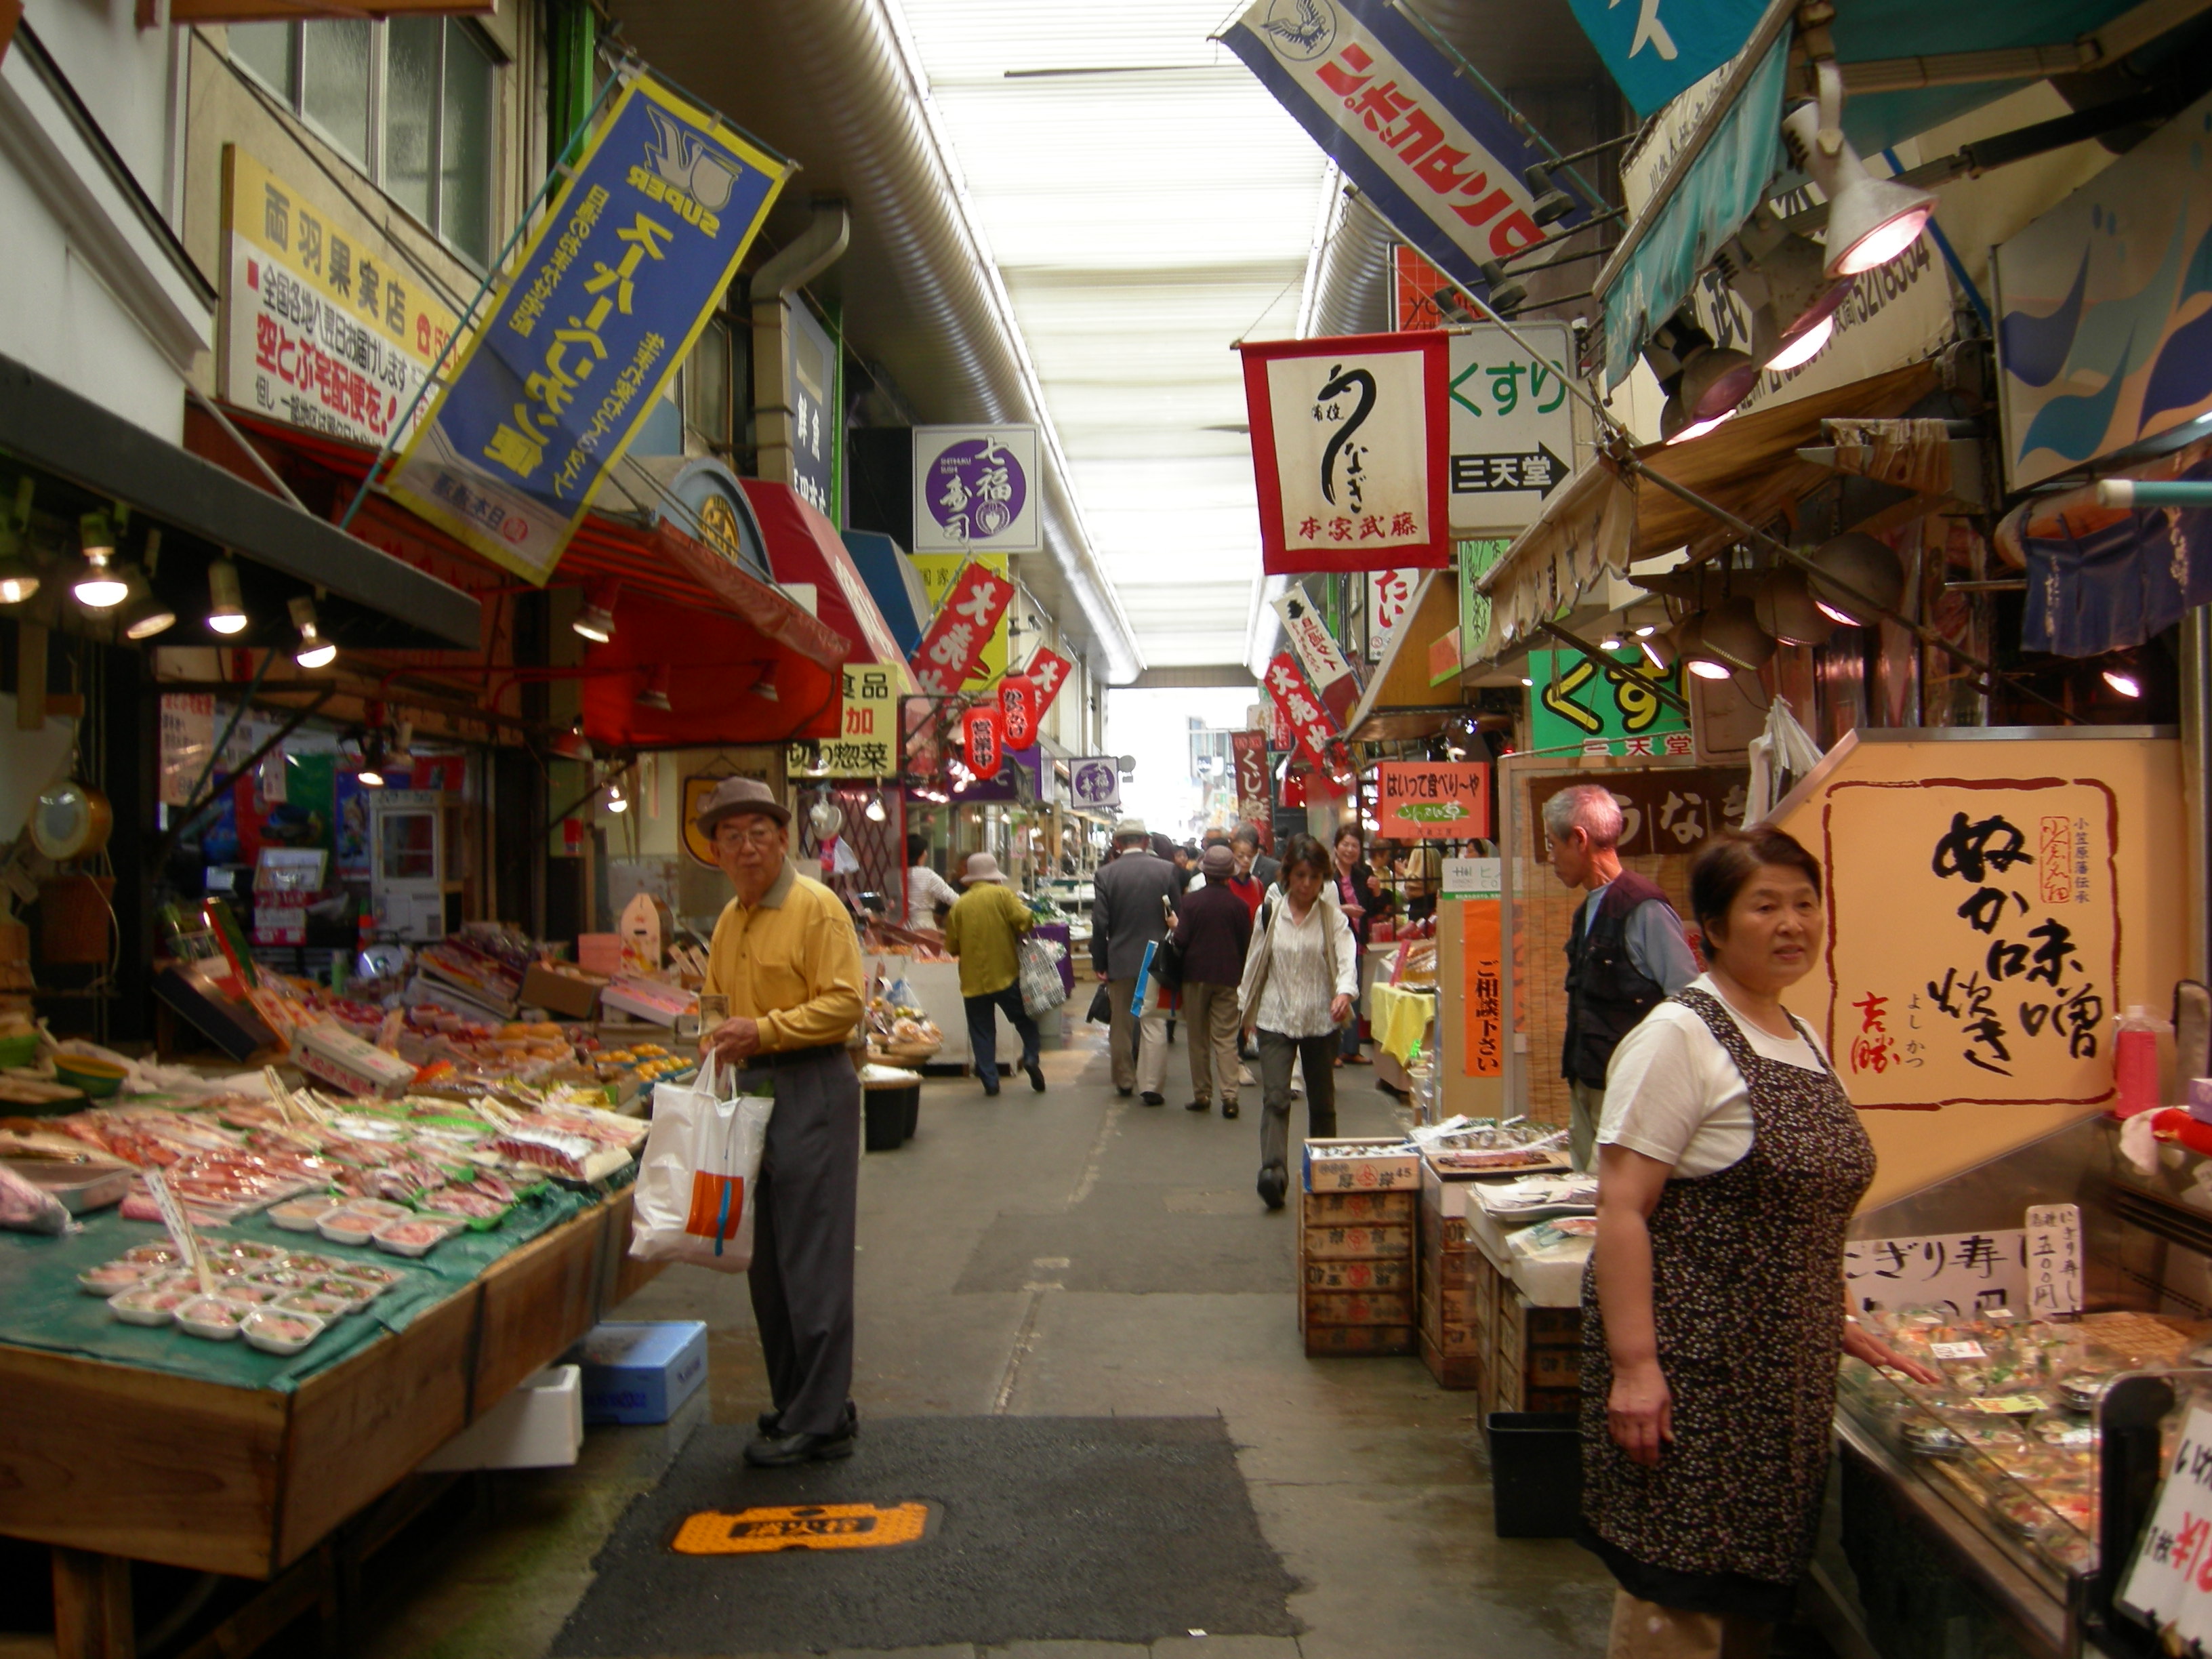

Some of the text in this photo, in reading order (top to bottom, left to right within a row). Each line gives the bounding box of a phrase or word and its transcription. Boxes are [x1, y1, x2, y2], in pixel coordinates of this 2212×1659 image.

[264, 181, 407, 337] 両羽果実店
[263, 263, 407, 394] 全国各地へ翌日お届けします
[1449, 360, 1566, 417] くすり
[975, 434, 1012, 503] 七福
[1317, 364, 1377, 514] うなぎ
[1457, 455, 1552, 491] 三天堂
[939, 474, 973, 544] 寿司
[1298, 512, 1419, 541] 本家武藤
[845, 706, 874, 735] 加
[1540, 654, 1690, 735] くす
[1906, 992, 1925, 1069] よしかつ
